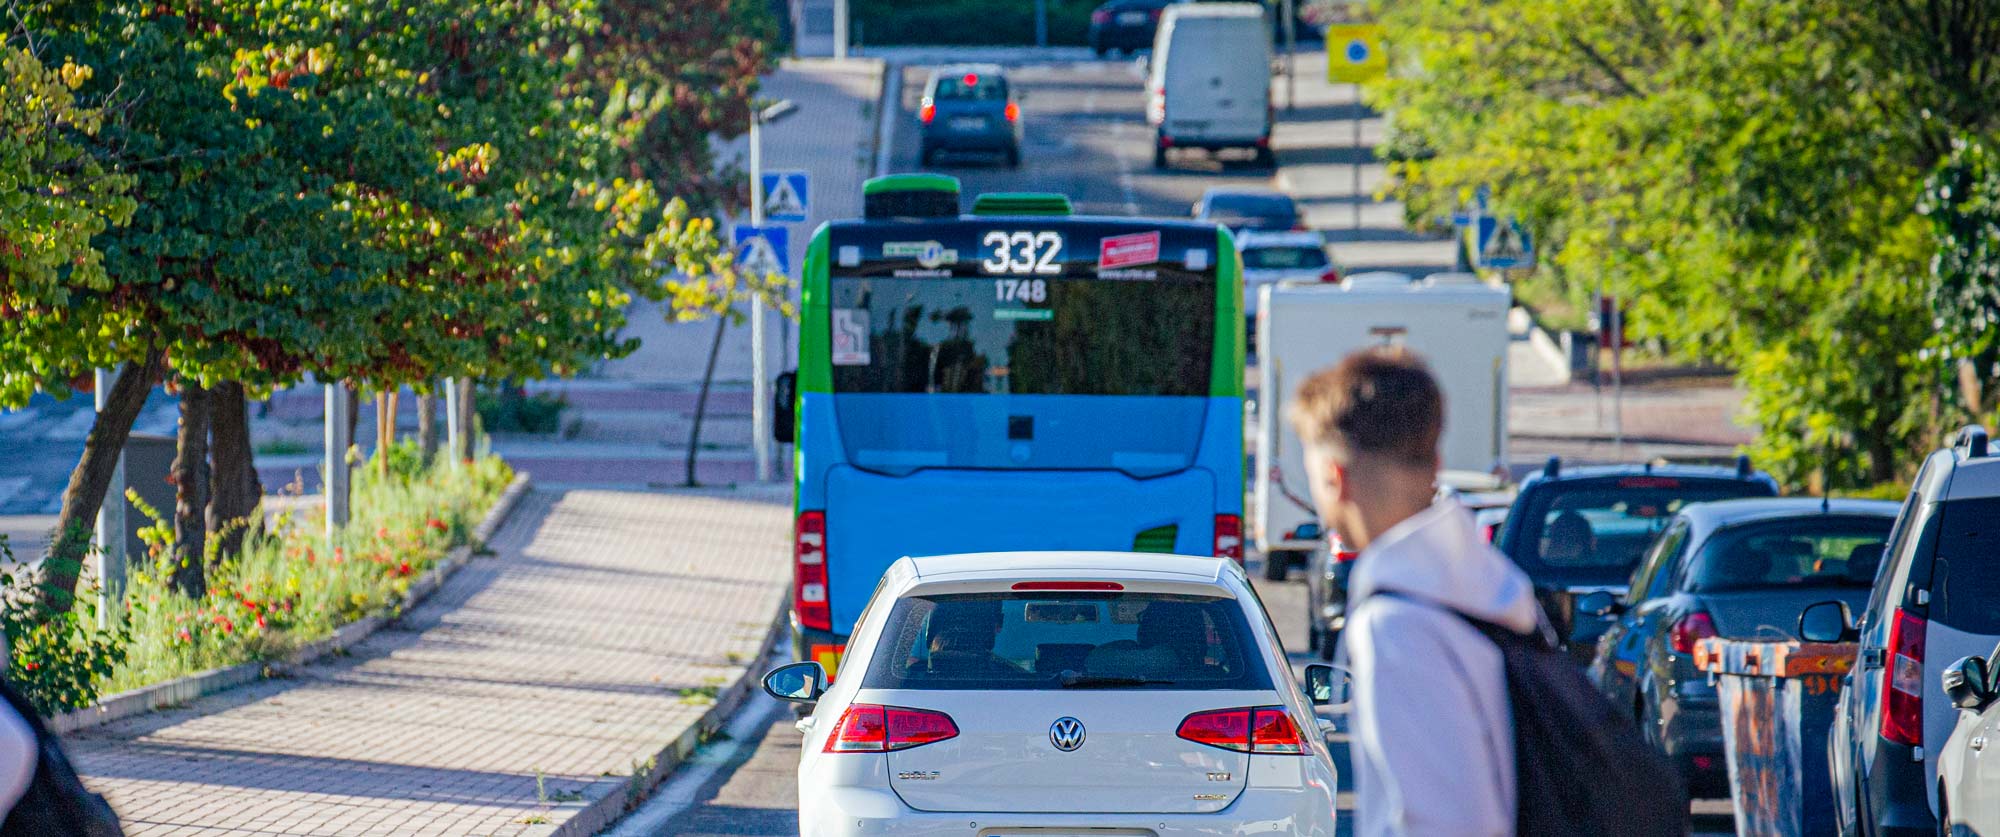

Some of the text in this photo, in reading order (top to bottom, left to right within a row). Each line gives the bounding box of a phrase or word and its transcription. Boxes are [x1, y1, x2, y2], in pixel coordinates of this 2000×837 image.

[983, 231, 1062, 273] 332
[995, 280, 1046, 303] 1748
[898, 771, 940, 780] GOLF
